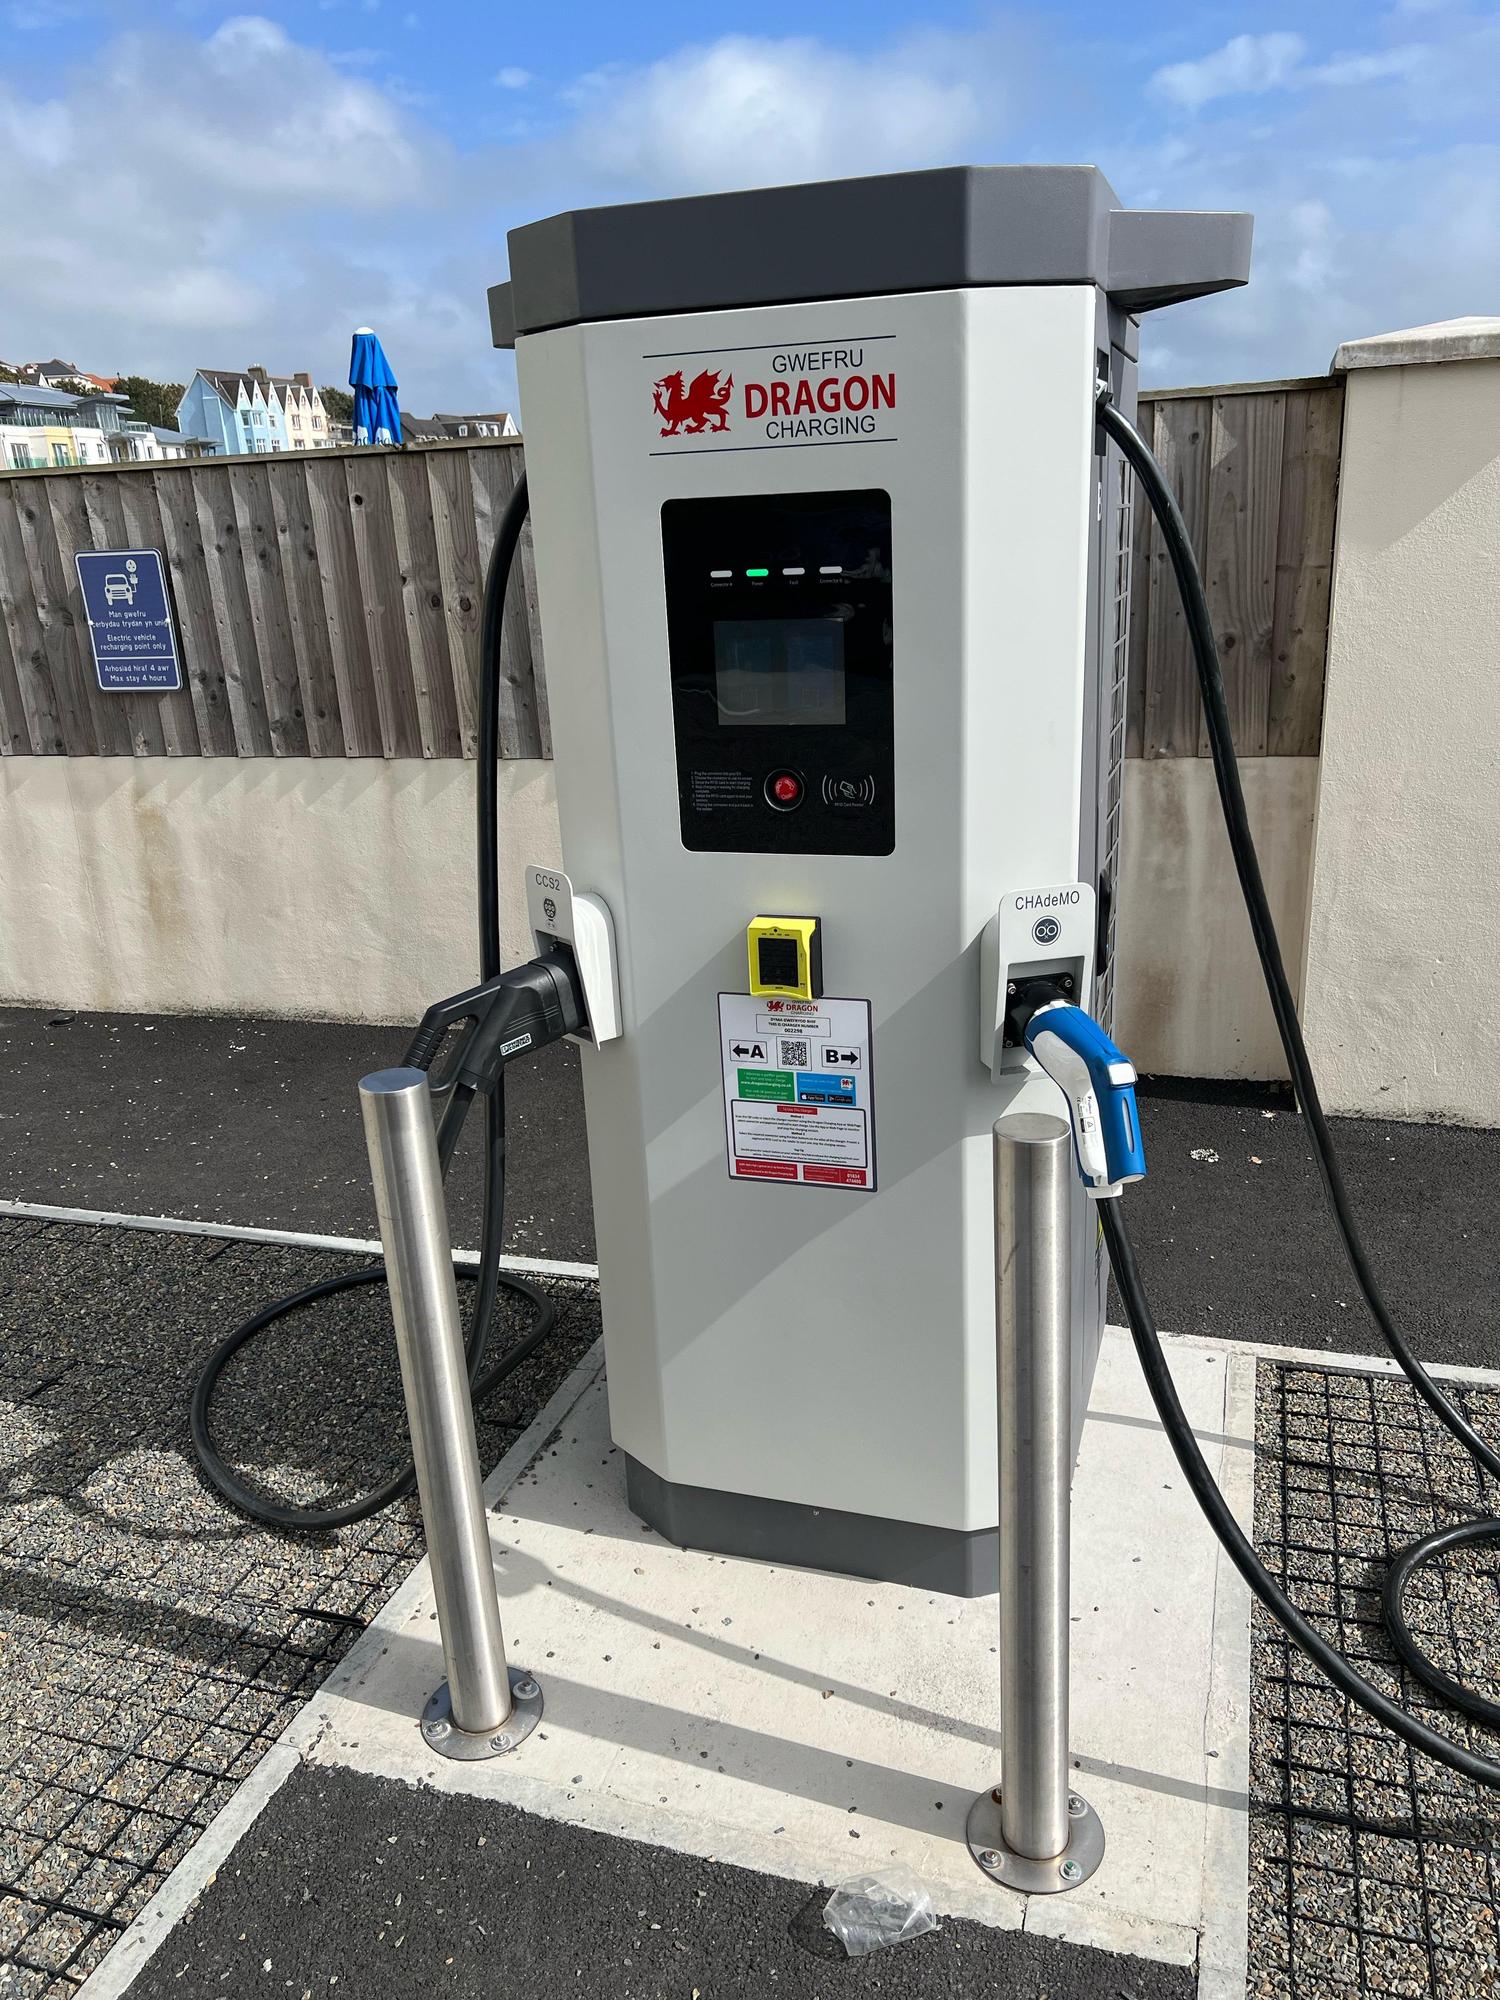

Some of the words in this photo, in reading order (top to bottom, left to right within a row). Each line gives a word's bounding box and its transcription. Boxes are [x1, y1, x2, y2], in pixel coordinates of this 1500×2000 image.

[772, 348, 863, 374] GWEFRU
[744, 373, 896, 419] DRAGON
[765, 415, 876, 440] CHARGING
[109, 610, 123, 618] Man
[124, 610, 147, 619] gwefru
[122, 620, 143, 628] trydan
[107, 634, 132, 642] Electric
[100, 643, 132, 652] recharging
[134, 643, 150, 651] point
[152, 643, 166, 651] only
[126, 675, 140, 683] stay
[149, 674, 167, 682] hours
[535, 873, 561, 891] CCS2
[1015, 890, 1080, 911] CHAdeMO
[786, 1004, 819, 1012] DRAGON
[750, 1045, 765, 1059] A
[825, 1049, 839, 1064] B
